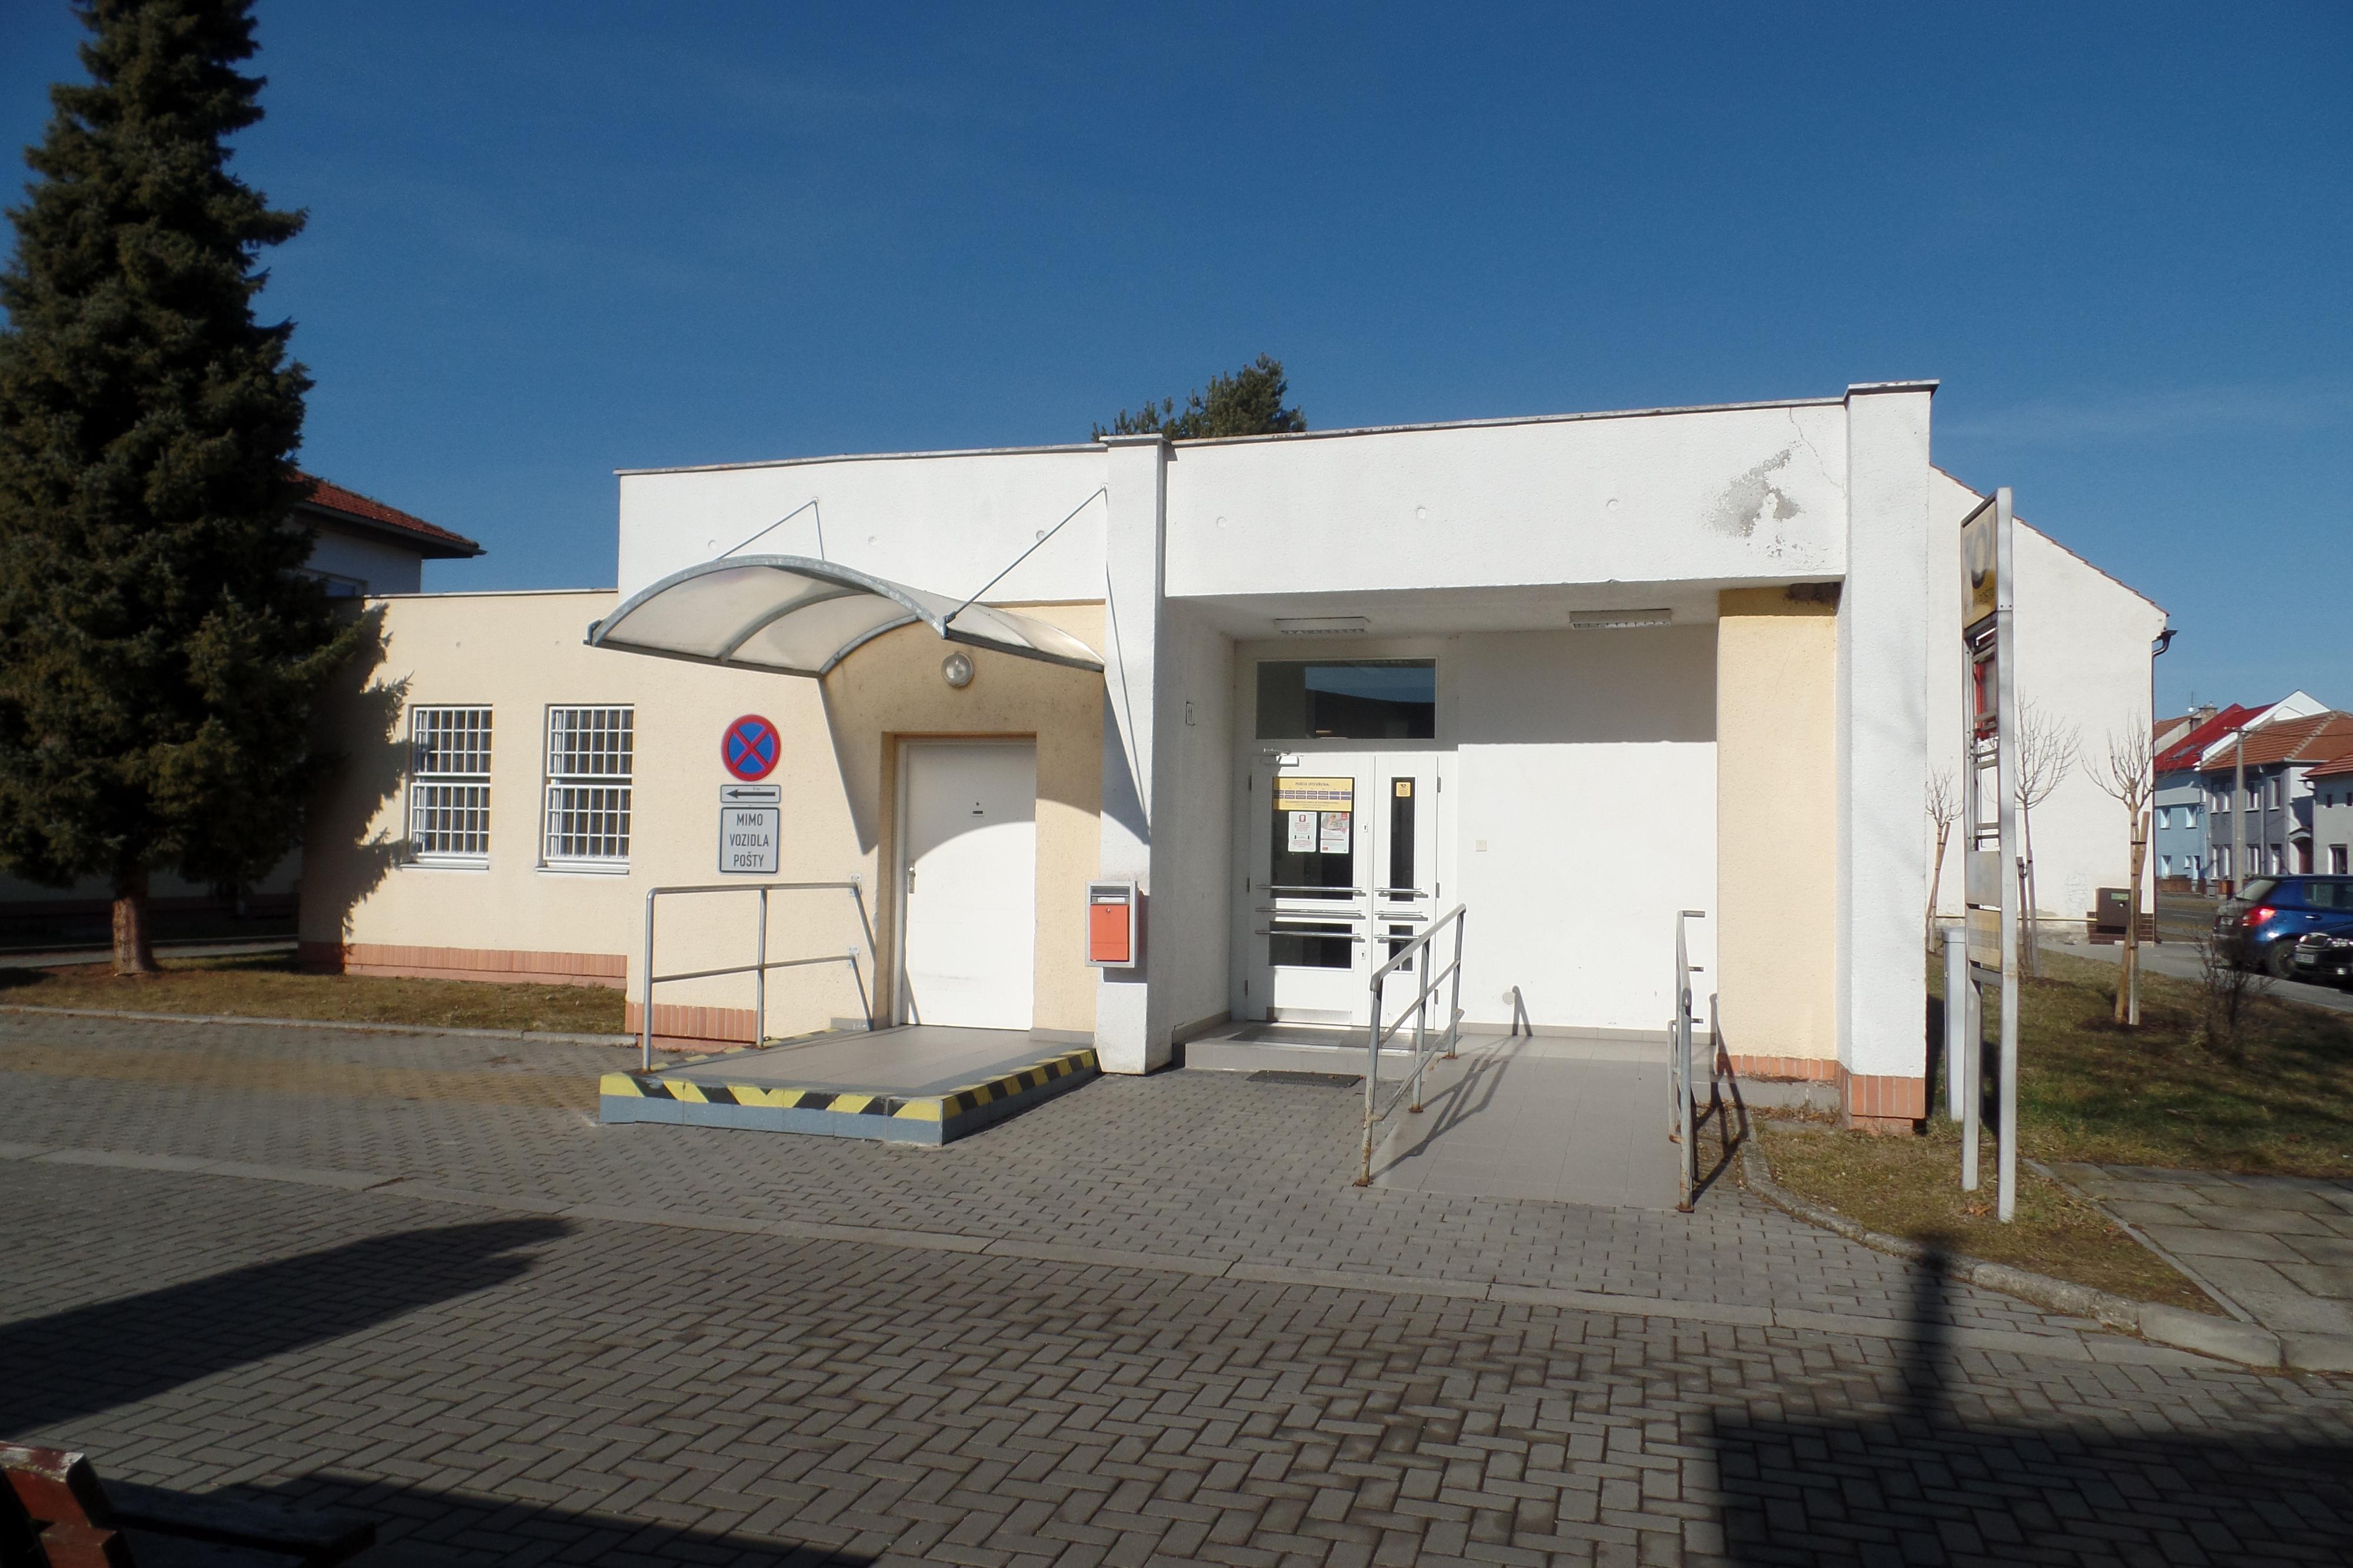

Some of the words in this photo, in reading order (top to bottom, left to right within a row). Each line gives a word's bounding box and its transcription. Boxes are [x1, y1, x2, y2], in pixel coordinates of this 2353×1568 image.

[736, 813, 763, 826] MIMO
[729, 833, 769, 847] VOZIDLA
[734, 852, 764, 868] POŠTY
